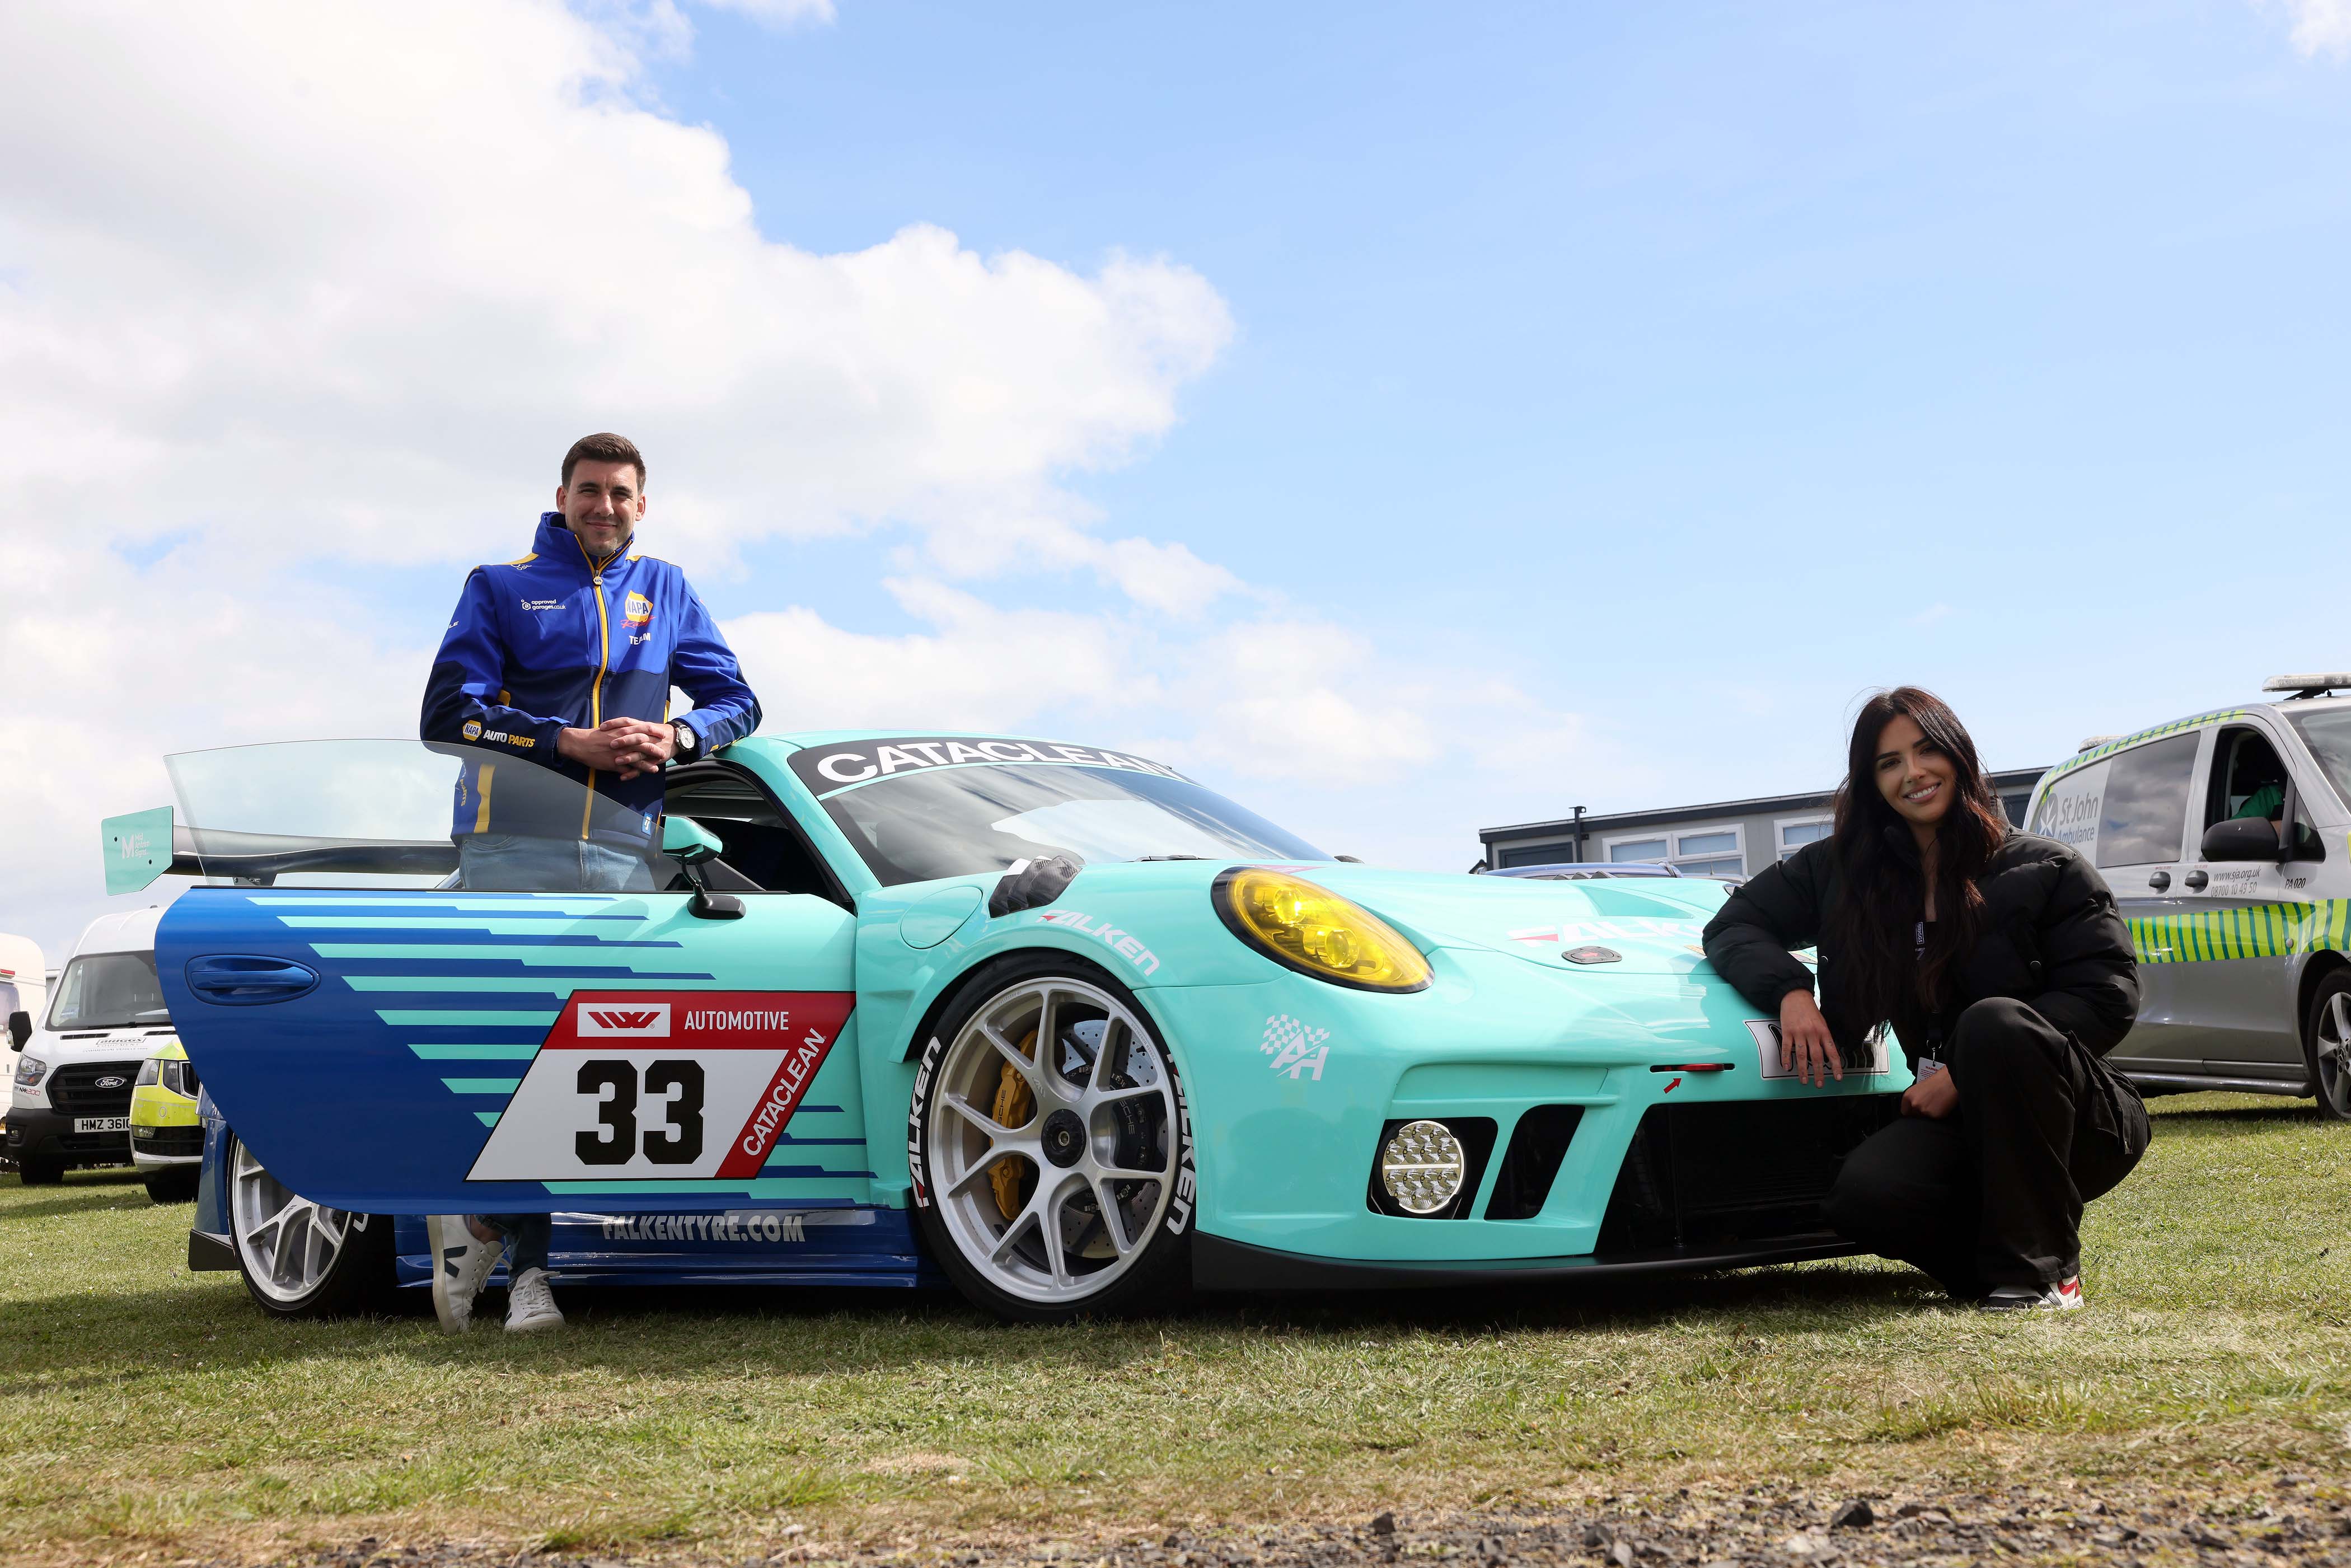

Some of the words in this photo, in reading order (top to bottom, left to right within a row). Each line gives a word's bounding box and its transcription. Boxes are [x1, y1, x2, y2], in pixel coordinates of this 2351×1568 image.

[626, 600, 649, 615] NAPA
[629, 632, 651, 645] TEAM
[465, 724, 479, 736] NAPA
[483, 729, 508, 742] AUTO
[508, 734, 535, 747] PARTS
[817, 742, 1185, 783] CATACLEAN
[2060, 797, 2072, 826] St
[2071, 792, 2099, 823] John
[2058, 825, 2095, 845] Ambulance
[2214, 865, 2261, 882] www.sja.org.uk
[2284, 878, 2293, 889] PA
[2294, 877, 2306, 888] 020
[2211, 884, 2229, 897] 08700
[2231, 884, 2237, 895] 10
[2240, 883, 2246, 894] 49
[2249, 882, 2257, 893] 50
[1036, 910, 1160, 976] FALKEN
[684, 1010, 789, 1030] AUTOMOTIVE
[743, 1028, 826, 1156] CATACLEAN
[575, 1060, 705, 1165] 33
[908, 1036, 942, 1209] FALKEN
[81, 1120, 104, 1130] HMZ
[603, 1215, 805, 1243] FALKENTYRE.COM
